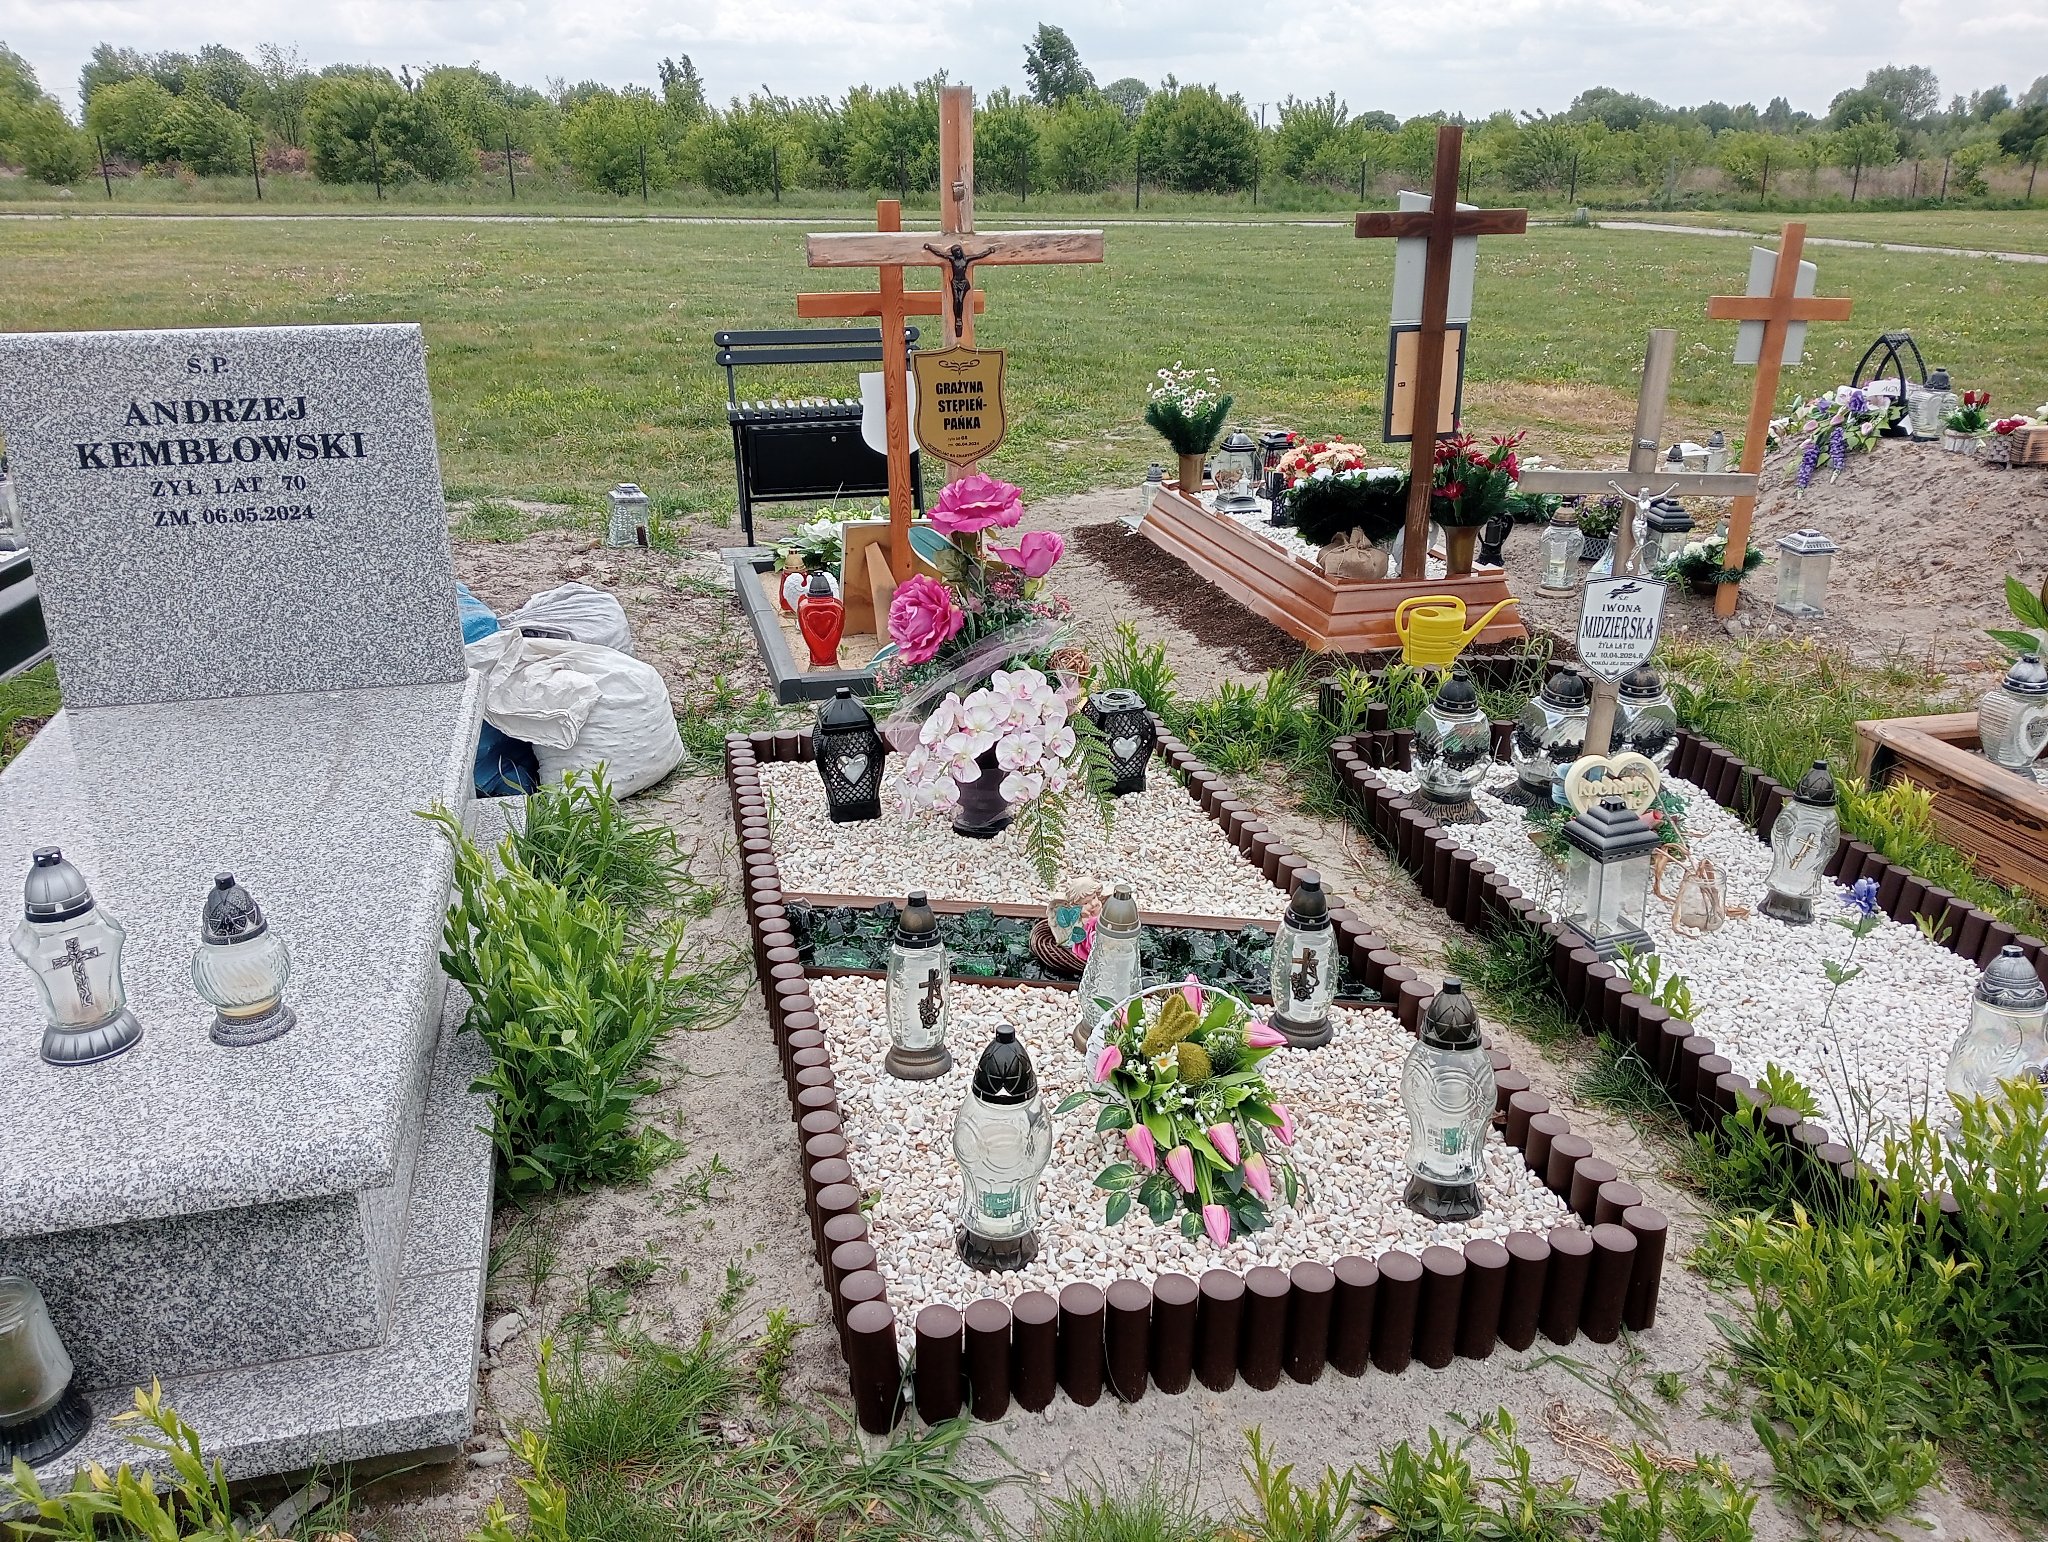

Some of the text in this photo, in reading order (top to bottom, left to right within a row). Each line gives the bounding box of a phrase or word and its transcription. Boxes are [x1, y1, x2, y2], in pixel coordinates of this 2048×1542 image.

[935, 380, 984, 395] GRAŻYNA
[124, 396, 307, 427] ANDRZEJ
[937, 396, 987, 414] STĘPIEŃ-
[943, 415, 981, 430] PAŃKA
[73, 432, 368, 470] KEMBŁOWSKI
[151, 475, 306, 497] ŻYŁ LAT 70
[153, 505, 317, 527] ZM. 06.05.2024
[1602, 603, 1642, 612] IWONA
[1582, 616, 1654, 640] MIDZIERSKA
